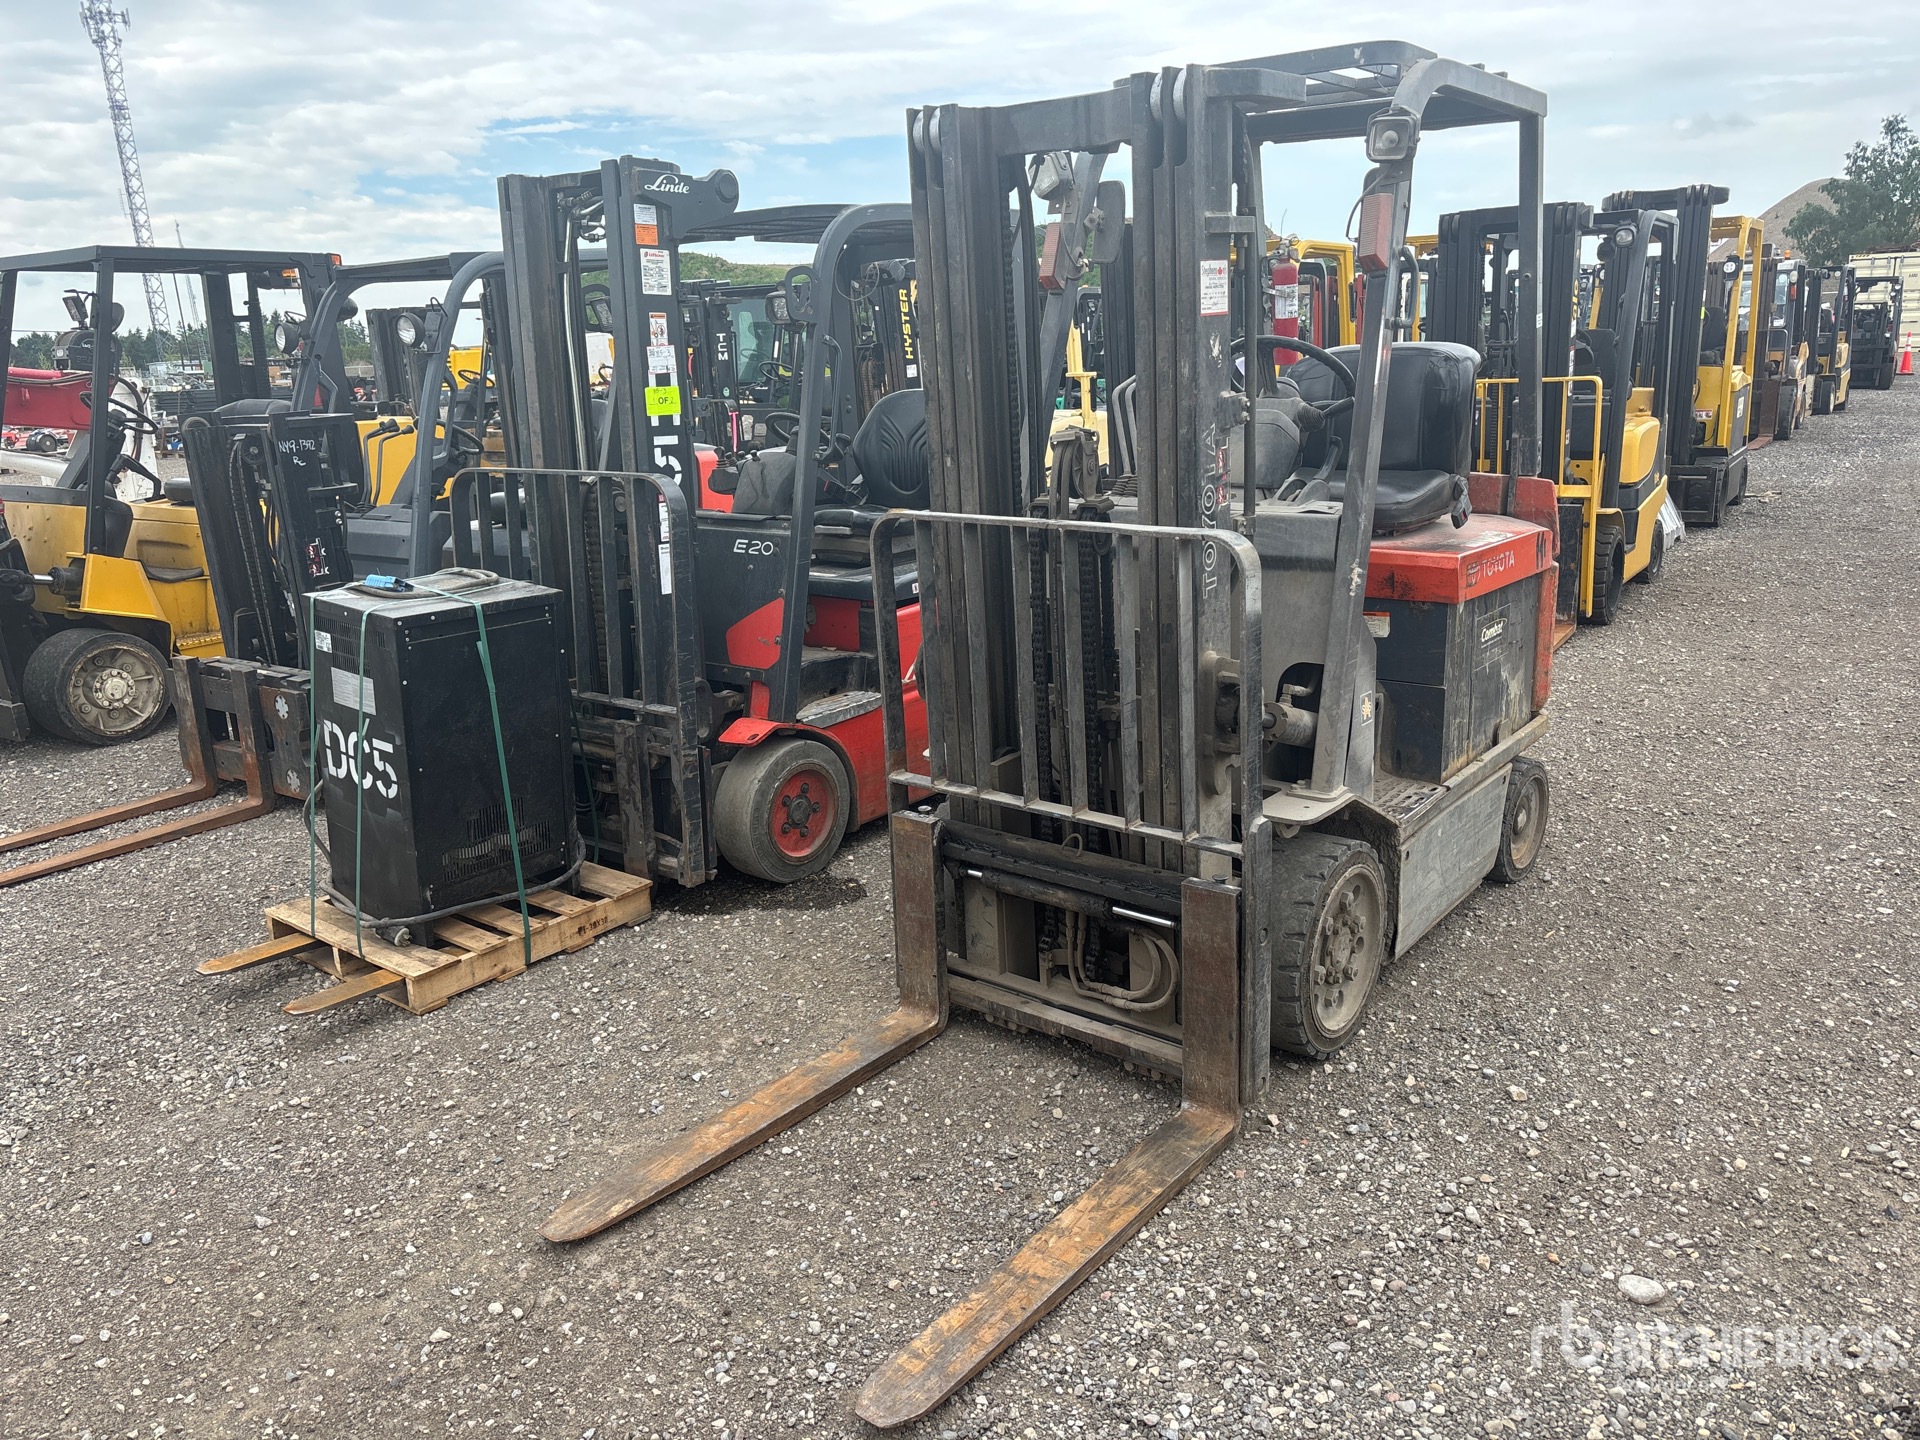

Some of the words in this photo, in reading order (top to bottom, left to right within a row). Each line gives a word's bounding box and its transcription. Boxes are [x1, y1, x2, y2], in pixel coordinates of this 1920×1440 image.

[644, 174, 690, 194] Linde
[898, 288, 914, 359] HYSTER
[716, 333, 729, 361] TCM
[733, 539, 774, 555] E20
[1482, 550, 1515, 578] TOYOTA
[322, 718, 399, 800] DC5
